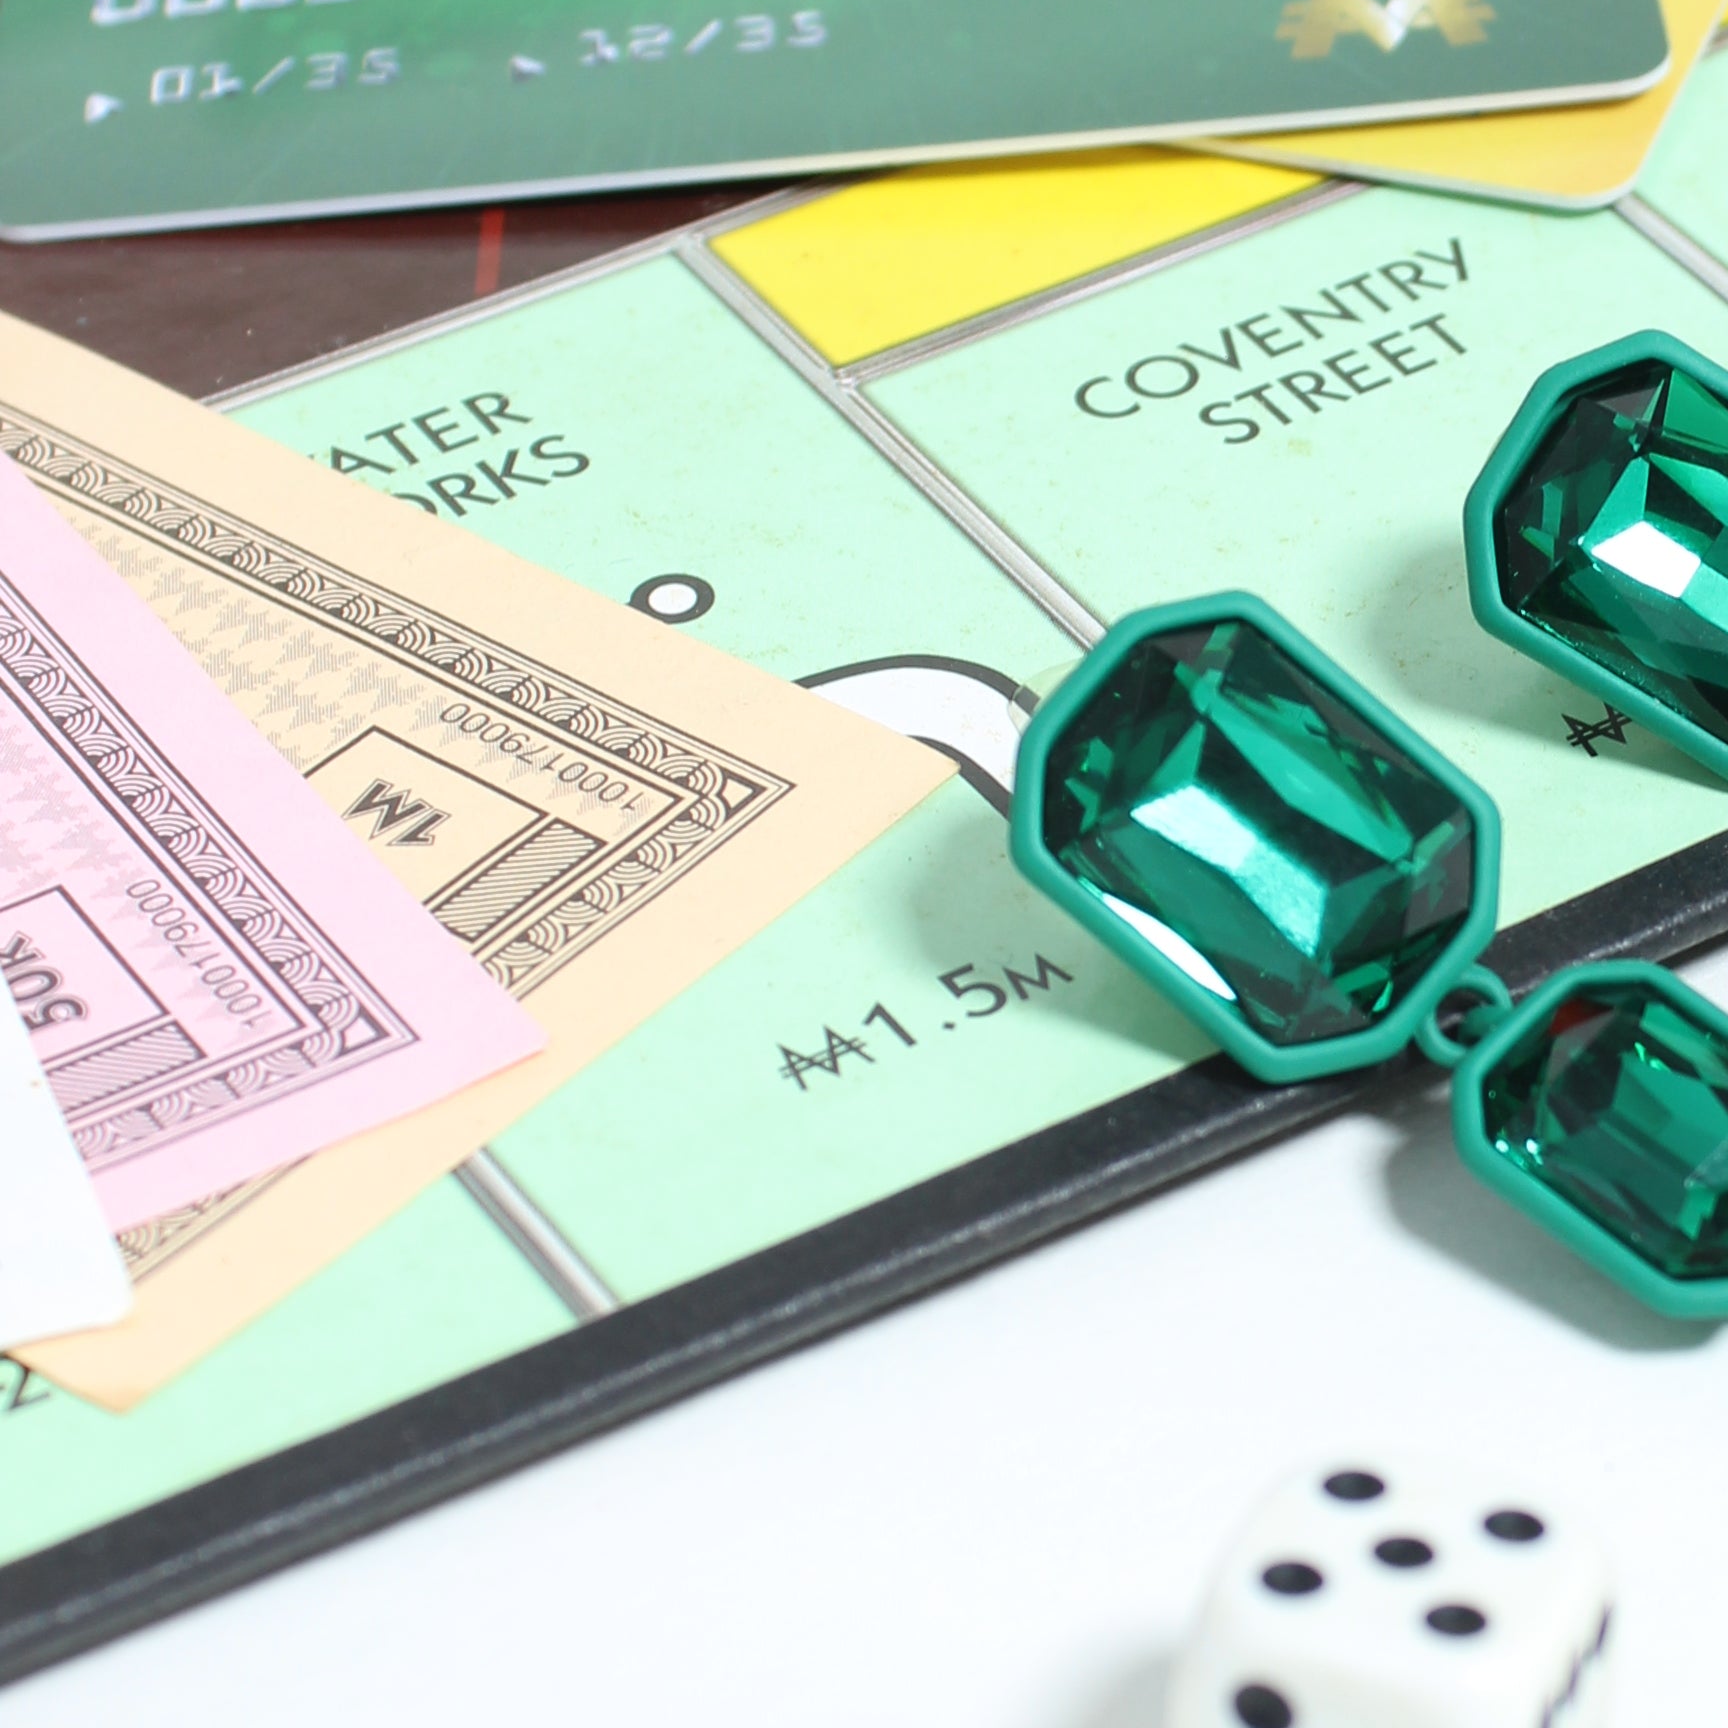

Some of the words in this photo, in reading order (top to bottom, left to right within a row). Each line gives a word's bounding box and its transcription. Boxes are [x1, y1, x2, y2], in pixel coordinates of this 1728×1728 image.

[150, 47, 398, 105] 01/35
[1073, 237, 1472, 421] COVENTRY
[1199, 313, 1472, 446] STREET
[307, 391, 535, 475] ATER
[341, 777, 452, 847] 1M
[440, 702, 646, 812] 1000179000
[125, 878, 274, 1031] 1000179000
